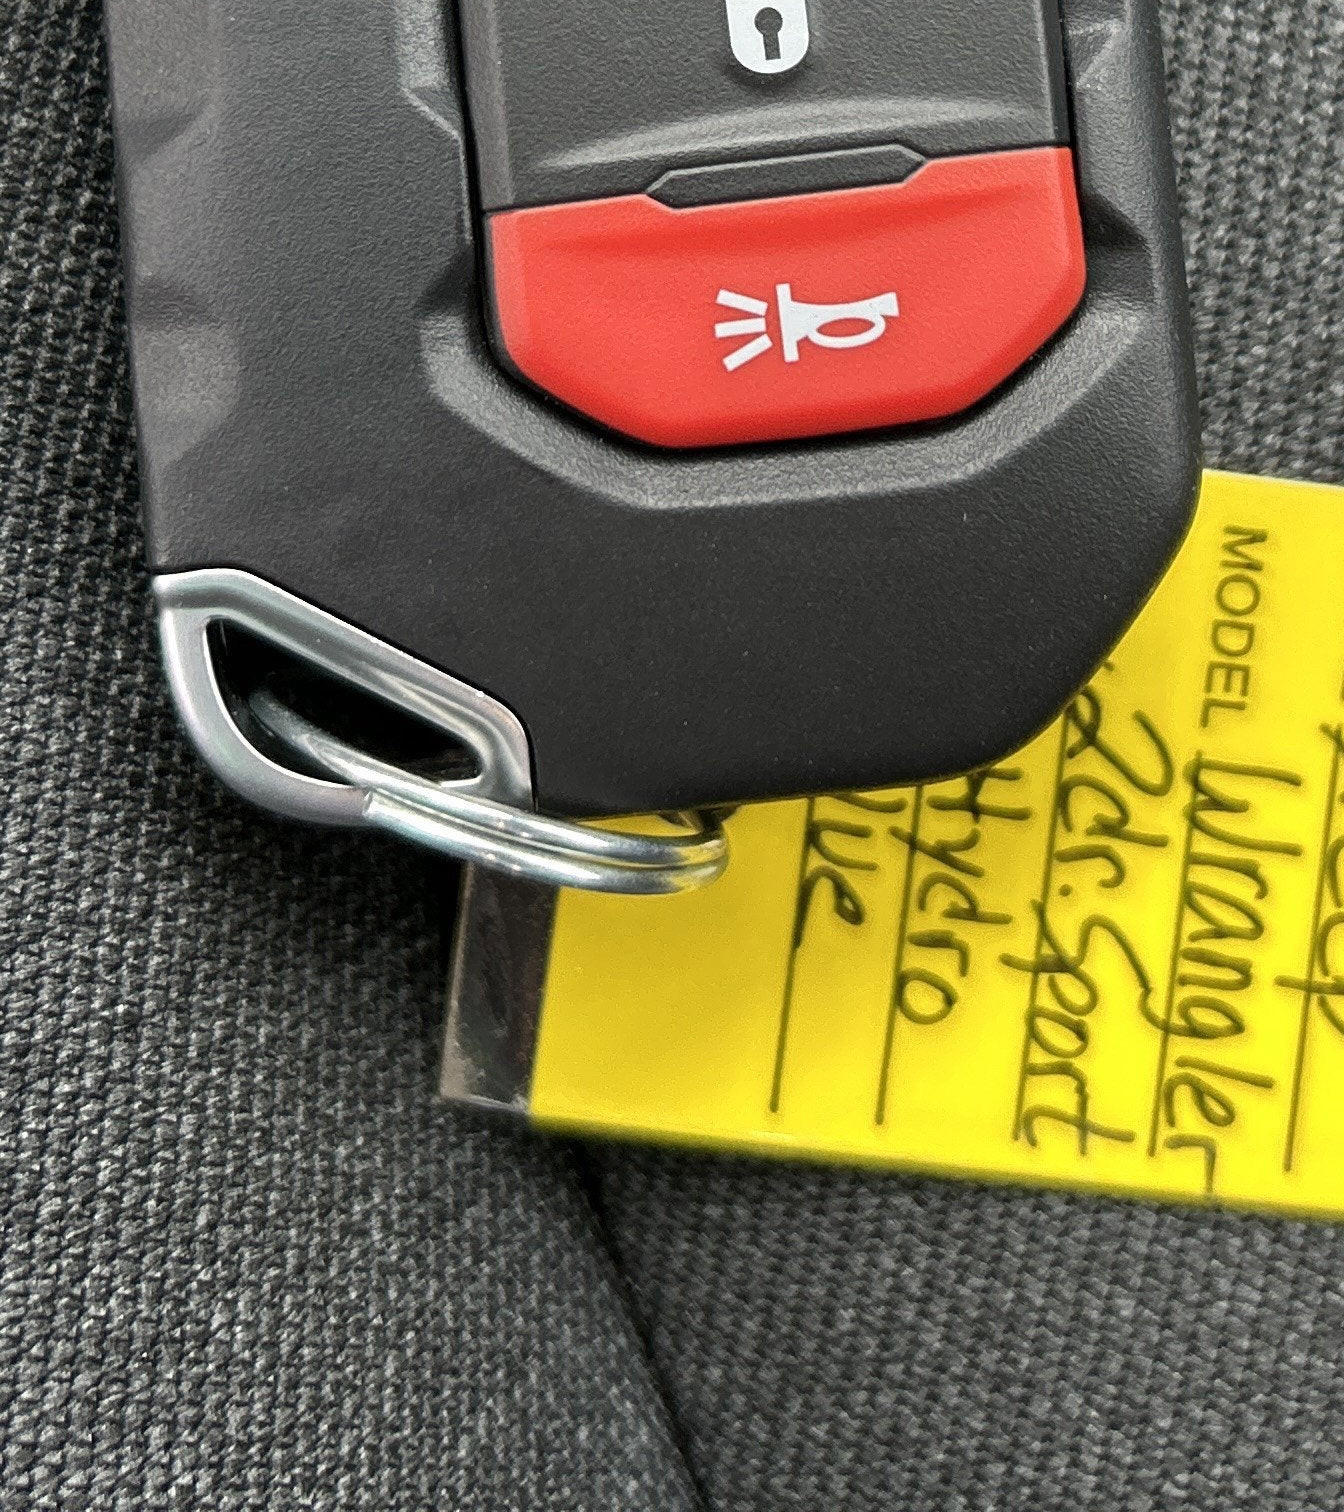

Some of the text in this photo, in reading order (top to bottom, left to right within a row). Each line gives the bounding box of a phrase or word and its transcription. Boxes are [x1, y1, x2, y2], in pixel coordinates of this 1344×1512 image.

[1198, 524, 1268, 730] MODEL
[795, 791, 908, 952] lue
[891, 768, 1033, 1026] Hydro
[1146, 752, 1304, 1196] Wrangler
[1001, 898, 1152, 1156] Sport
